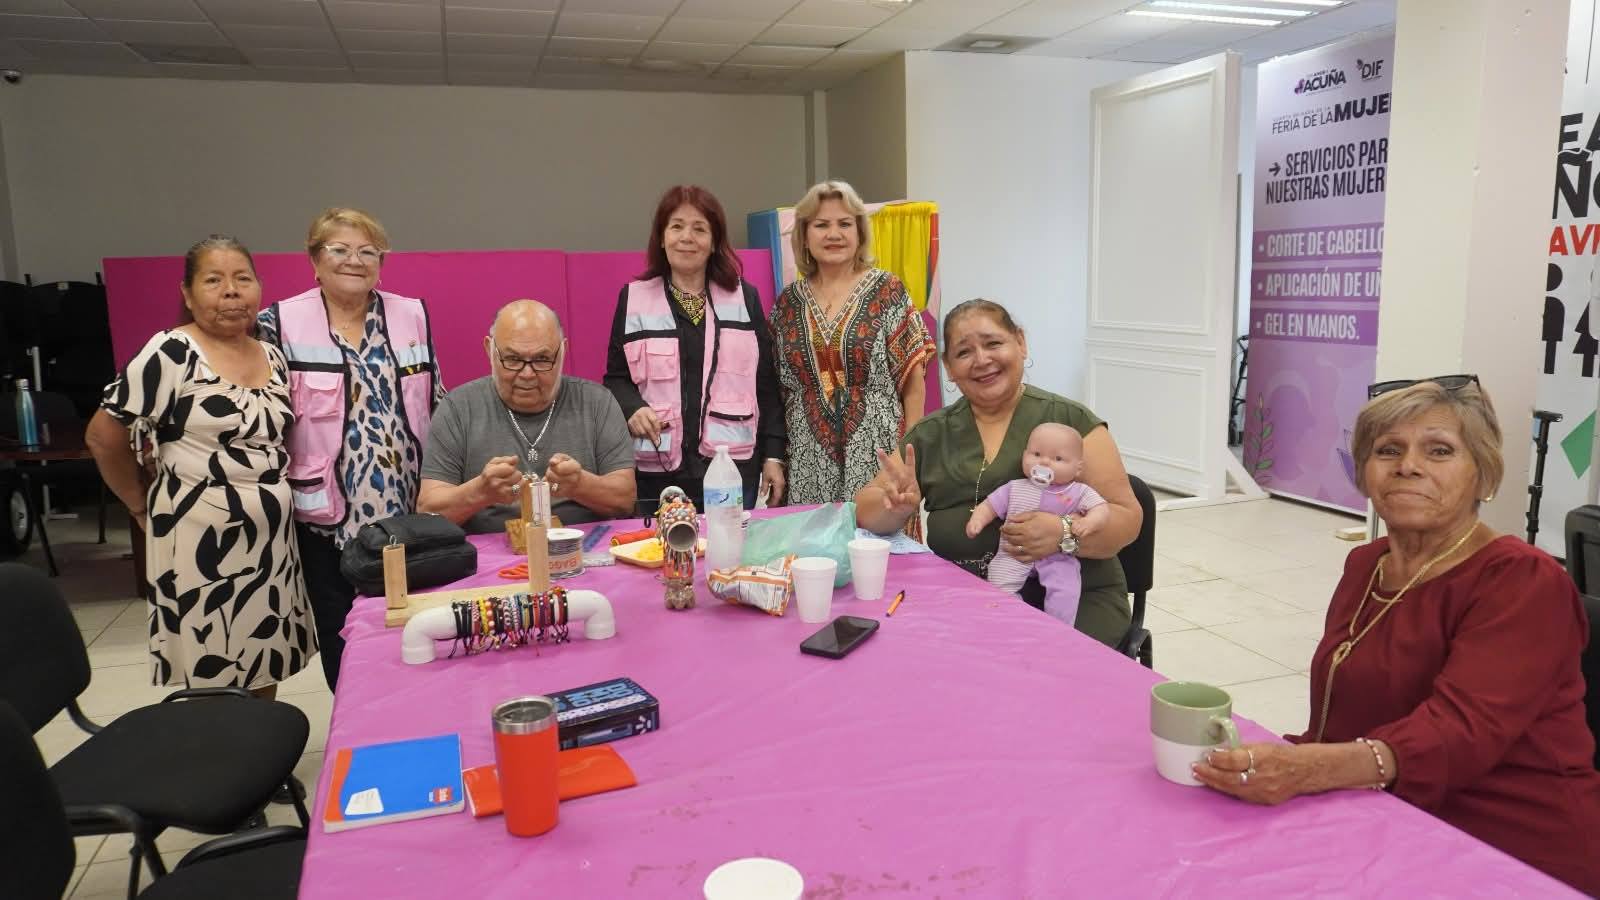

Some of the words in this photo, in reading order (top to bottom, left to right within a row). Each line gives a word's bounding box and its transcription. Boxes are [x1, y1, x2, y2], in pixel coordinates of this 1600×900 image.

[1303, 68, 1346, 93] ACUÑA
[1361, 59, 1384, 79] DIF
[1272, 118, 1300, 134] FERIA
[1303, 114, 1318, 128] DE
[1320, 111, 1333, 125] LA
[1334, 92, 1392, 123] MUJE
[1285, 143, 1355, 177] SERVICIOS
[1358, 137, 1388, 166] PAR
[1266, 174, 1329, 204] NUESTRAS
[1332, 166, 1385, 197] MUJER
[1267, 232, 1305, 257] CORTE
[1307, 231, 1325, 255] DE
[1265, 266, 1340, 297] APLICACIÓN
[1344, 272, 1362, 297] DE
[1264, 313, 1286, 336] GEL
[1288, 313, 1304, 337] EN
[1307, 314, 1360, 340] MANOS.
